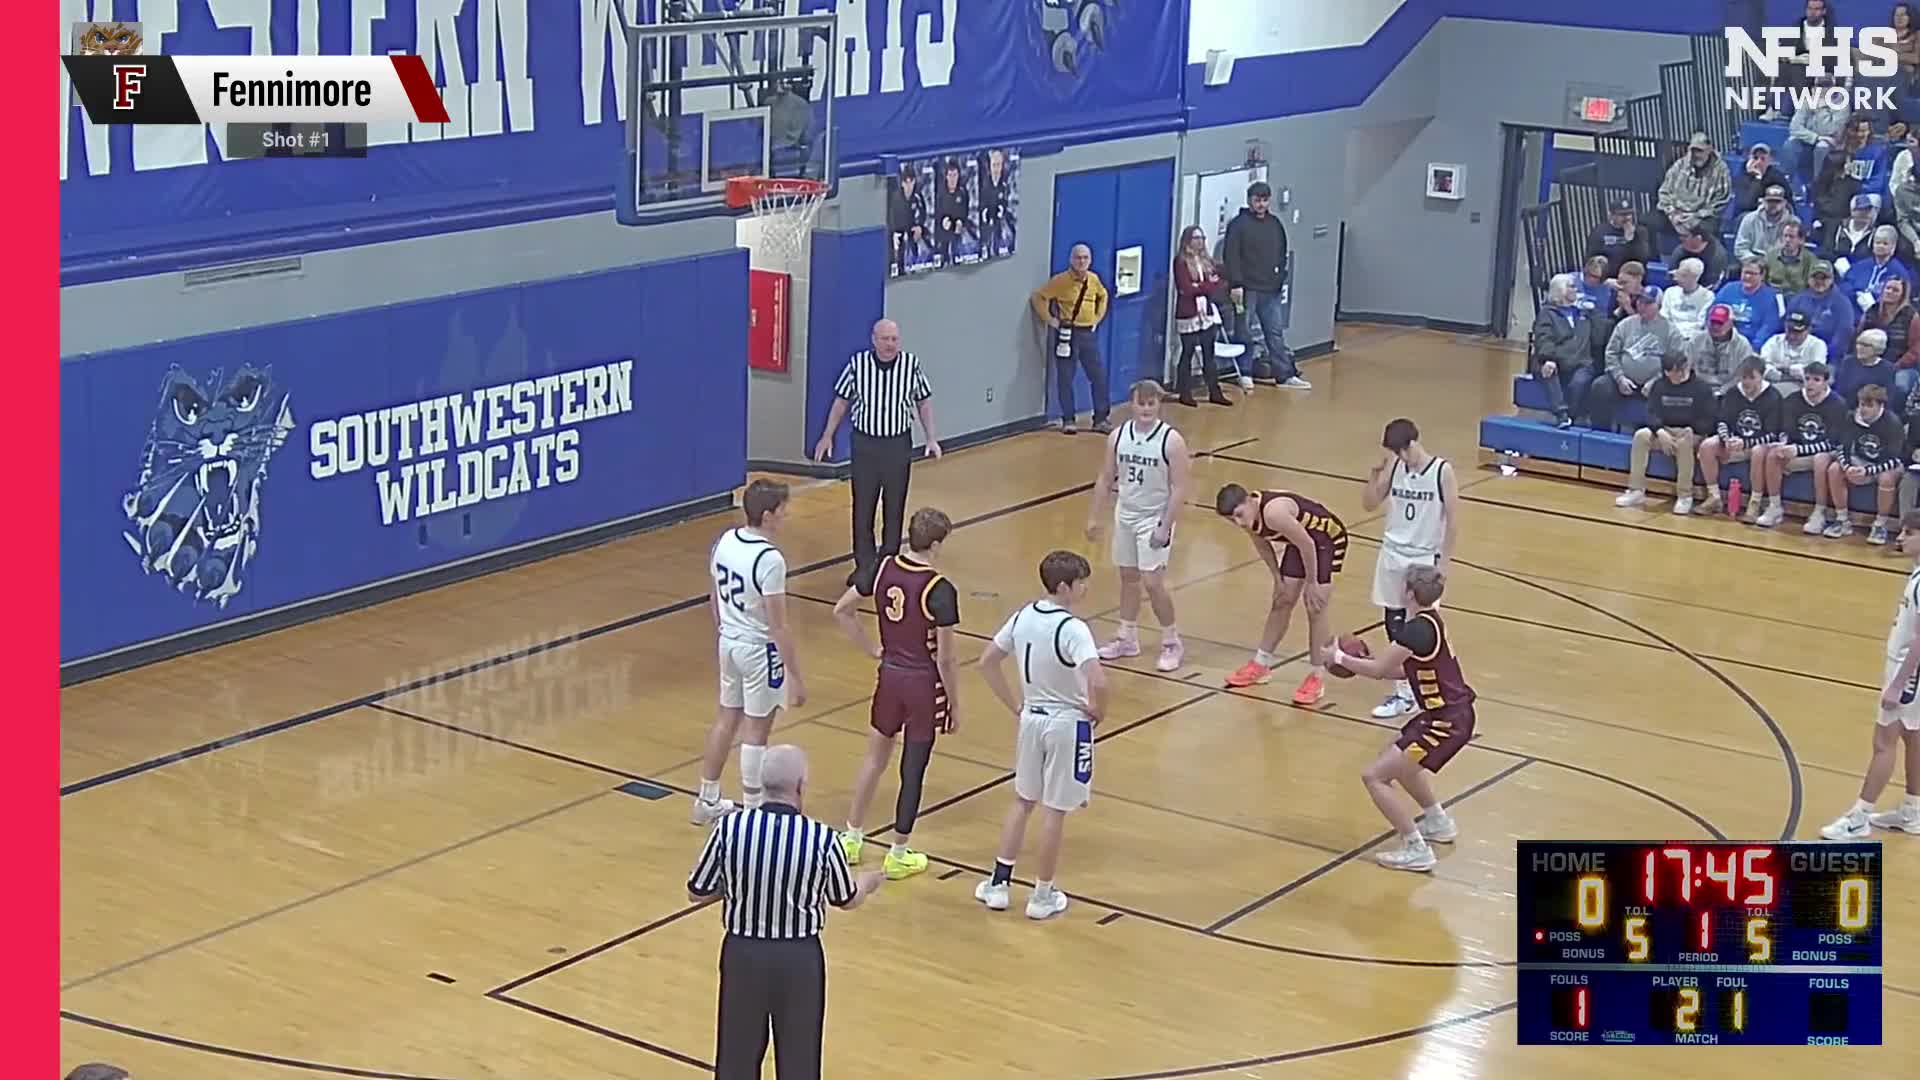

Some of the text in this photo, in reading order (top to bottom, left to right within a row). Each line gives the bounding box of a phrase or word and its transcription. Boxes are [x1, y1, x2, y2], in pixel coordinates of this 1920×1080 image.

[310, 360, 633, 479] SOUTHWESTERN
[376, 429, 580, 525] WILDCATS
[1119, 454, 1159, 467] WILDCATS
[1128, 467, 1144, 486] 34
[1392, 488, 1435, 501] WILDCATS
[1404, 503, 1416, 521] 0
[716, 563, 746, 612] 22
[885, 586, 906, 622] 3
[1024, 642, 1033, 684] 1
[1078, 741, 1092, 773] SW
